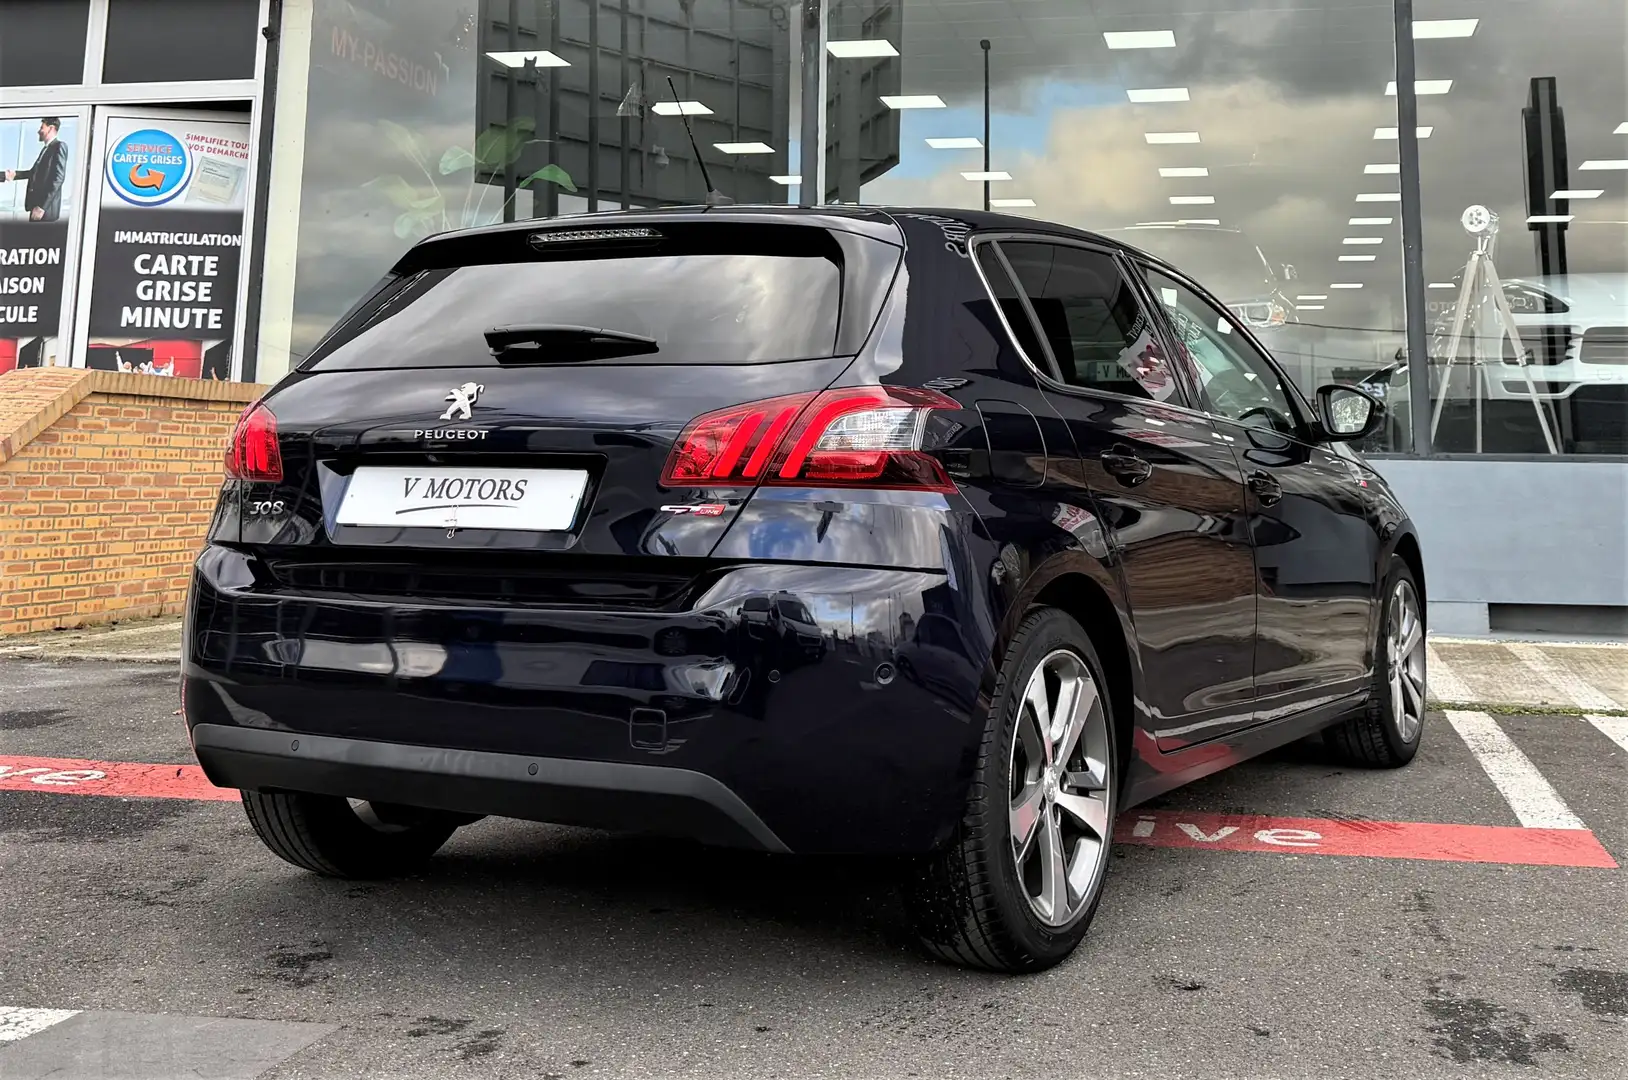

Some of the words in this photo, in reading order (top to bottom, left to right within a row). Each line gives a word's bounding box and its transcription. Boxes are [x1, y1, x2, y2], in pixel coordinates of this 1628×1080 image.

[185, 133, 229, 146] SIMPLIFIEZ
[126, 143, 173, 154] SERVICE
[113, 154, 149, 164] CARTES
[151, 155, 183, 165] GRISES
[114, 231, 242, 246] IMMATRICULATION
[134, 253, 219, 276] CARTE
[136, 280, 213, 302] GRISE
[120, 306, 223, 329] MINUTE
[414, 429, 489, 440] PEUGEOT
[404, 477, 421, 498] V
[422, 478, 528, 501] MOTORS
[250, 501, 284, 515] 308
